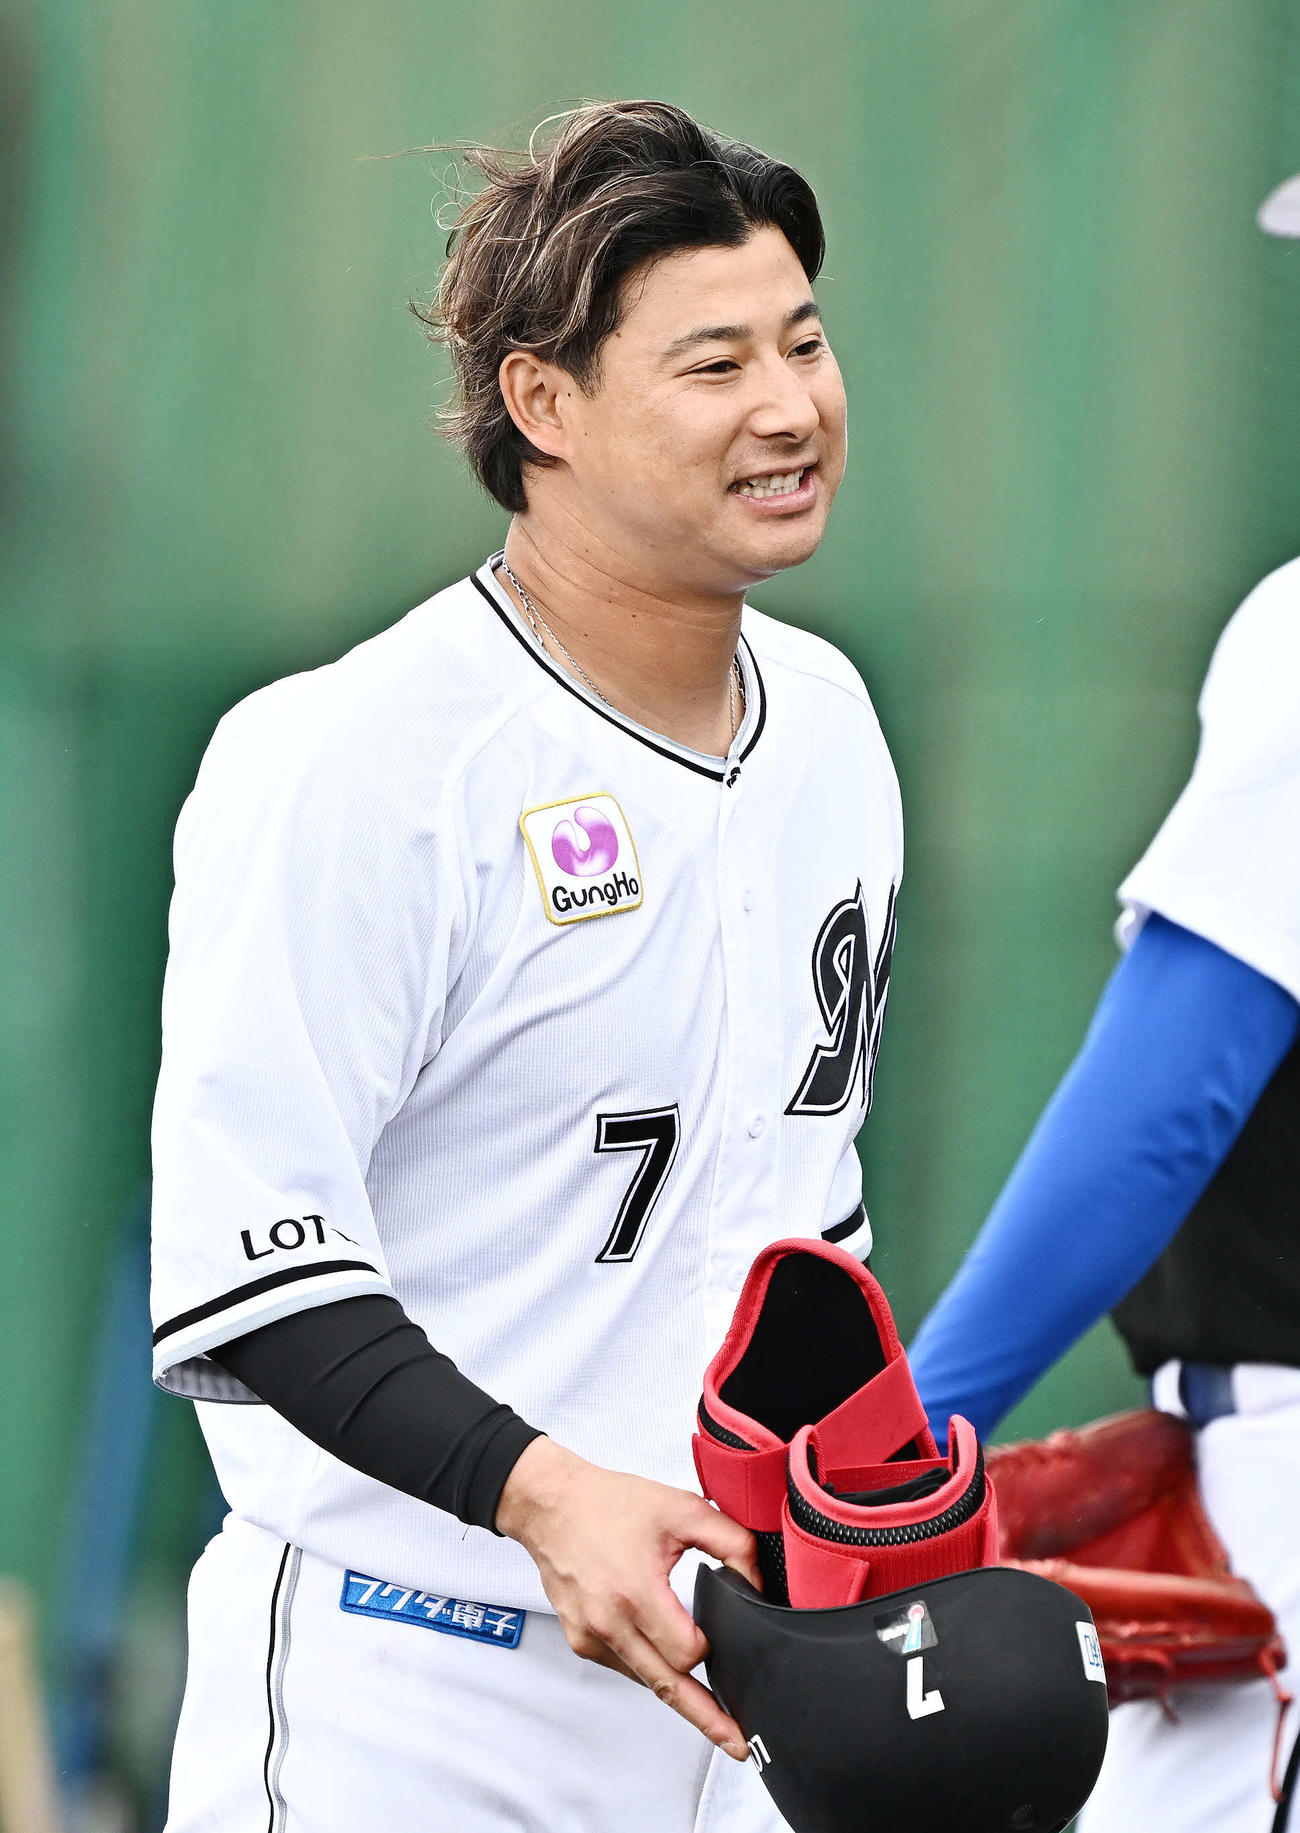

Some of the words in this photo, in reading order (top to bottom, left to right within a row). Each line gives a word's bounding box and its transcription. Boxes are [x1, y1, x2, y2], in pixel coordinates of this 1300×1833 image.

[552, 872, 639, 912] GungHo
[594, 1103, 681, 1263] 7
[241, 1215, 361, 1261] LOT
[349, 1576, 517, 1636] フクダ電子
[906, 1656, 945, 1720] 7
